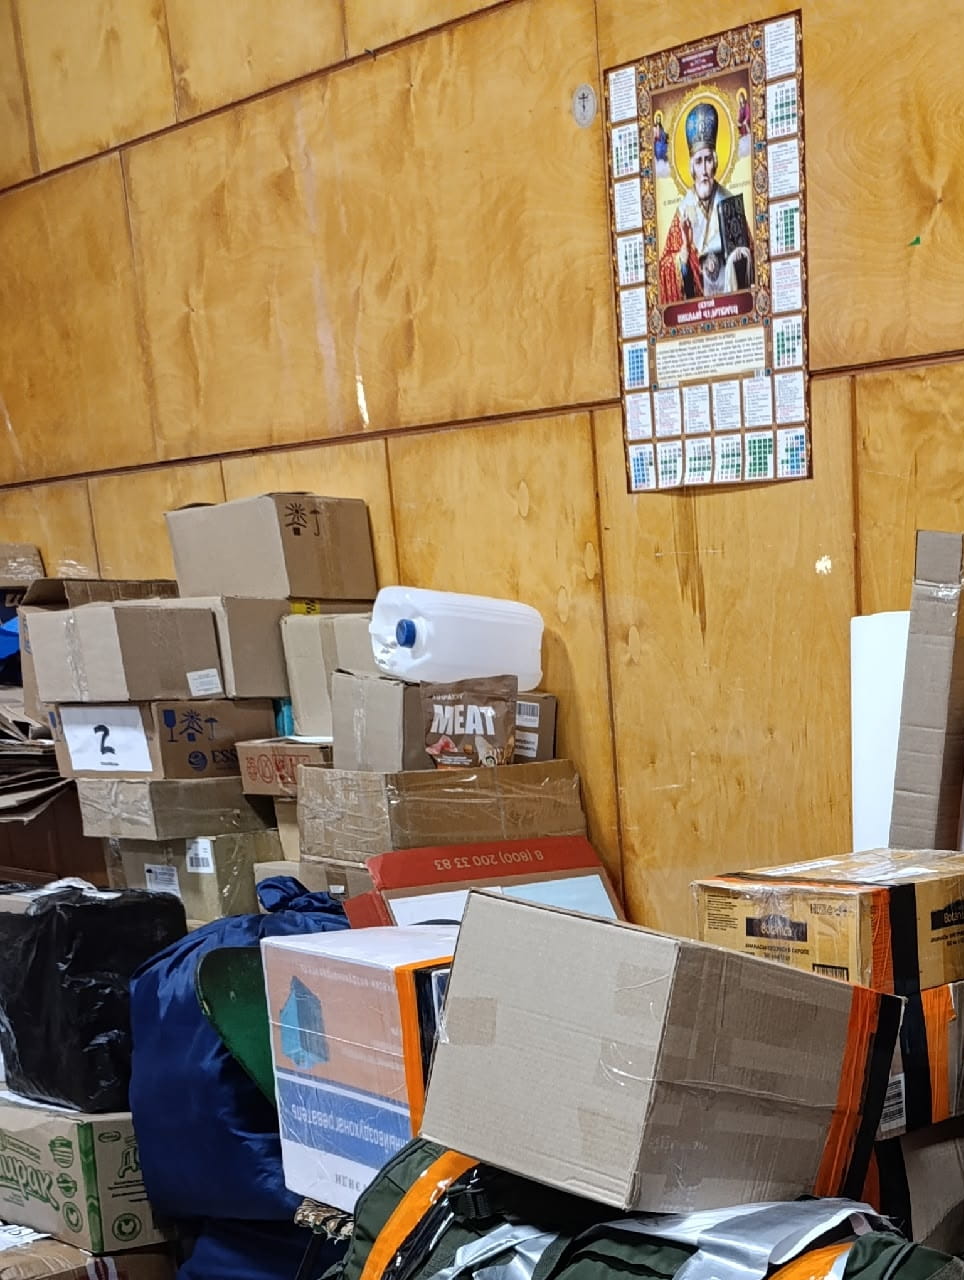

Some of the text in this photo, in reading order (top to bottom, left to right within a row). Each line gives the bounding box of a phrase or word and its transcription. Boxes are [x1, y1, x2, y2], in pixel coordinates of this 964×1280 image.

[430, 704, 496, 735] MEAT
[93, 724, 115, 755] 2
[433, 849, 544, 871] 8 (800) 200 33 83
